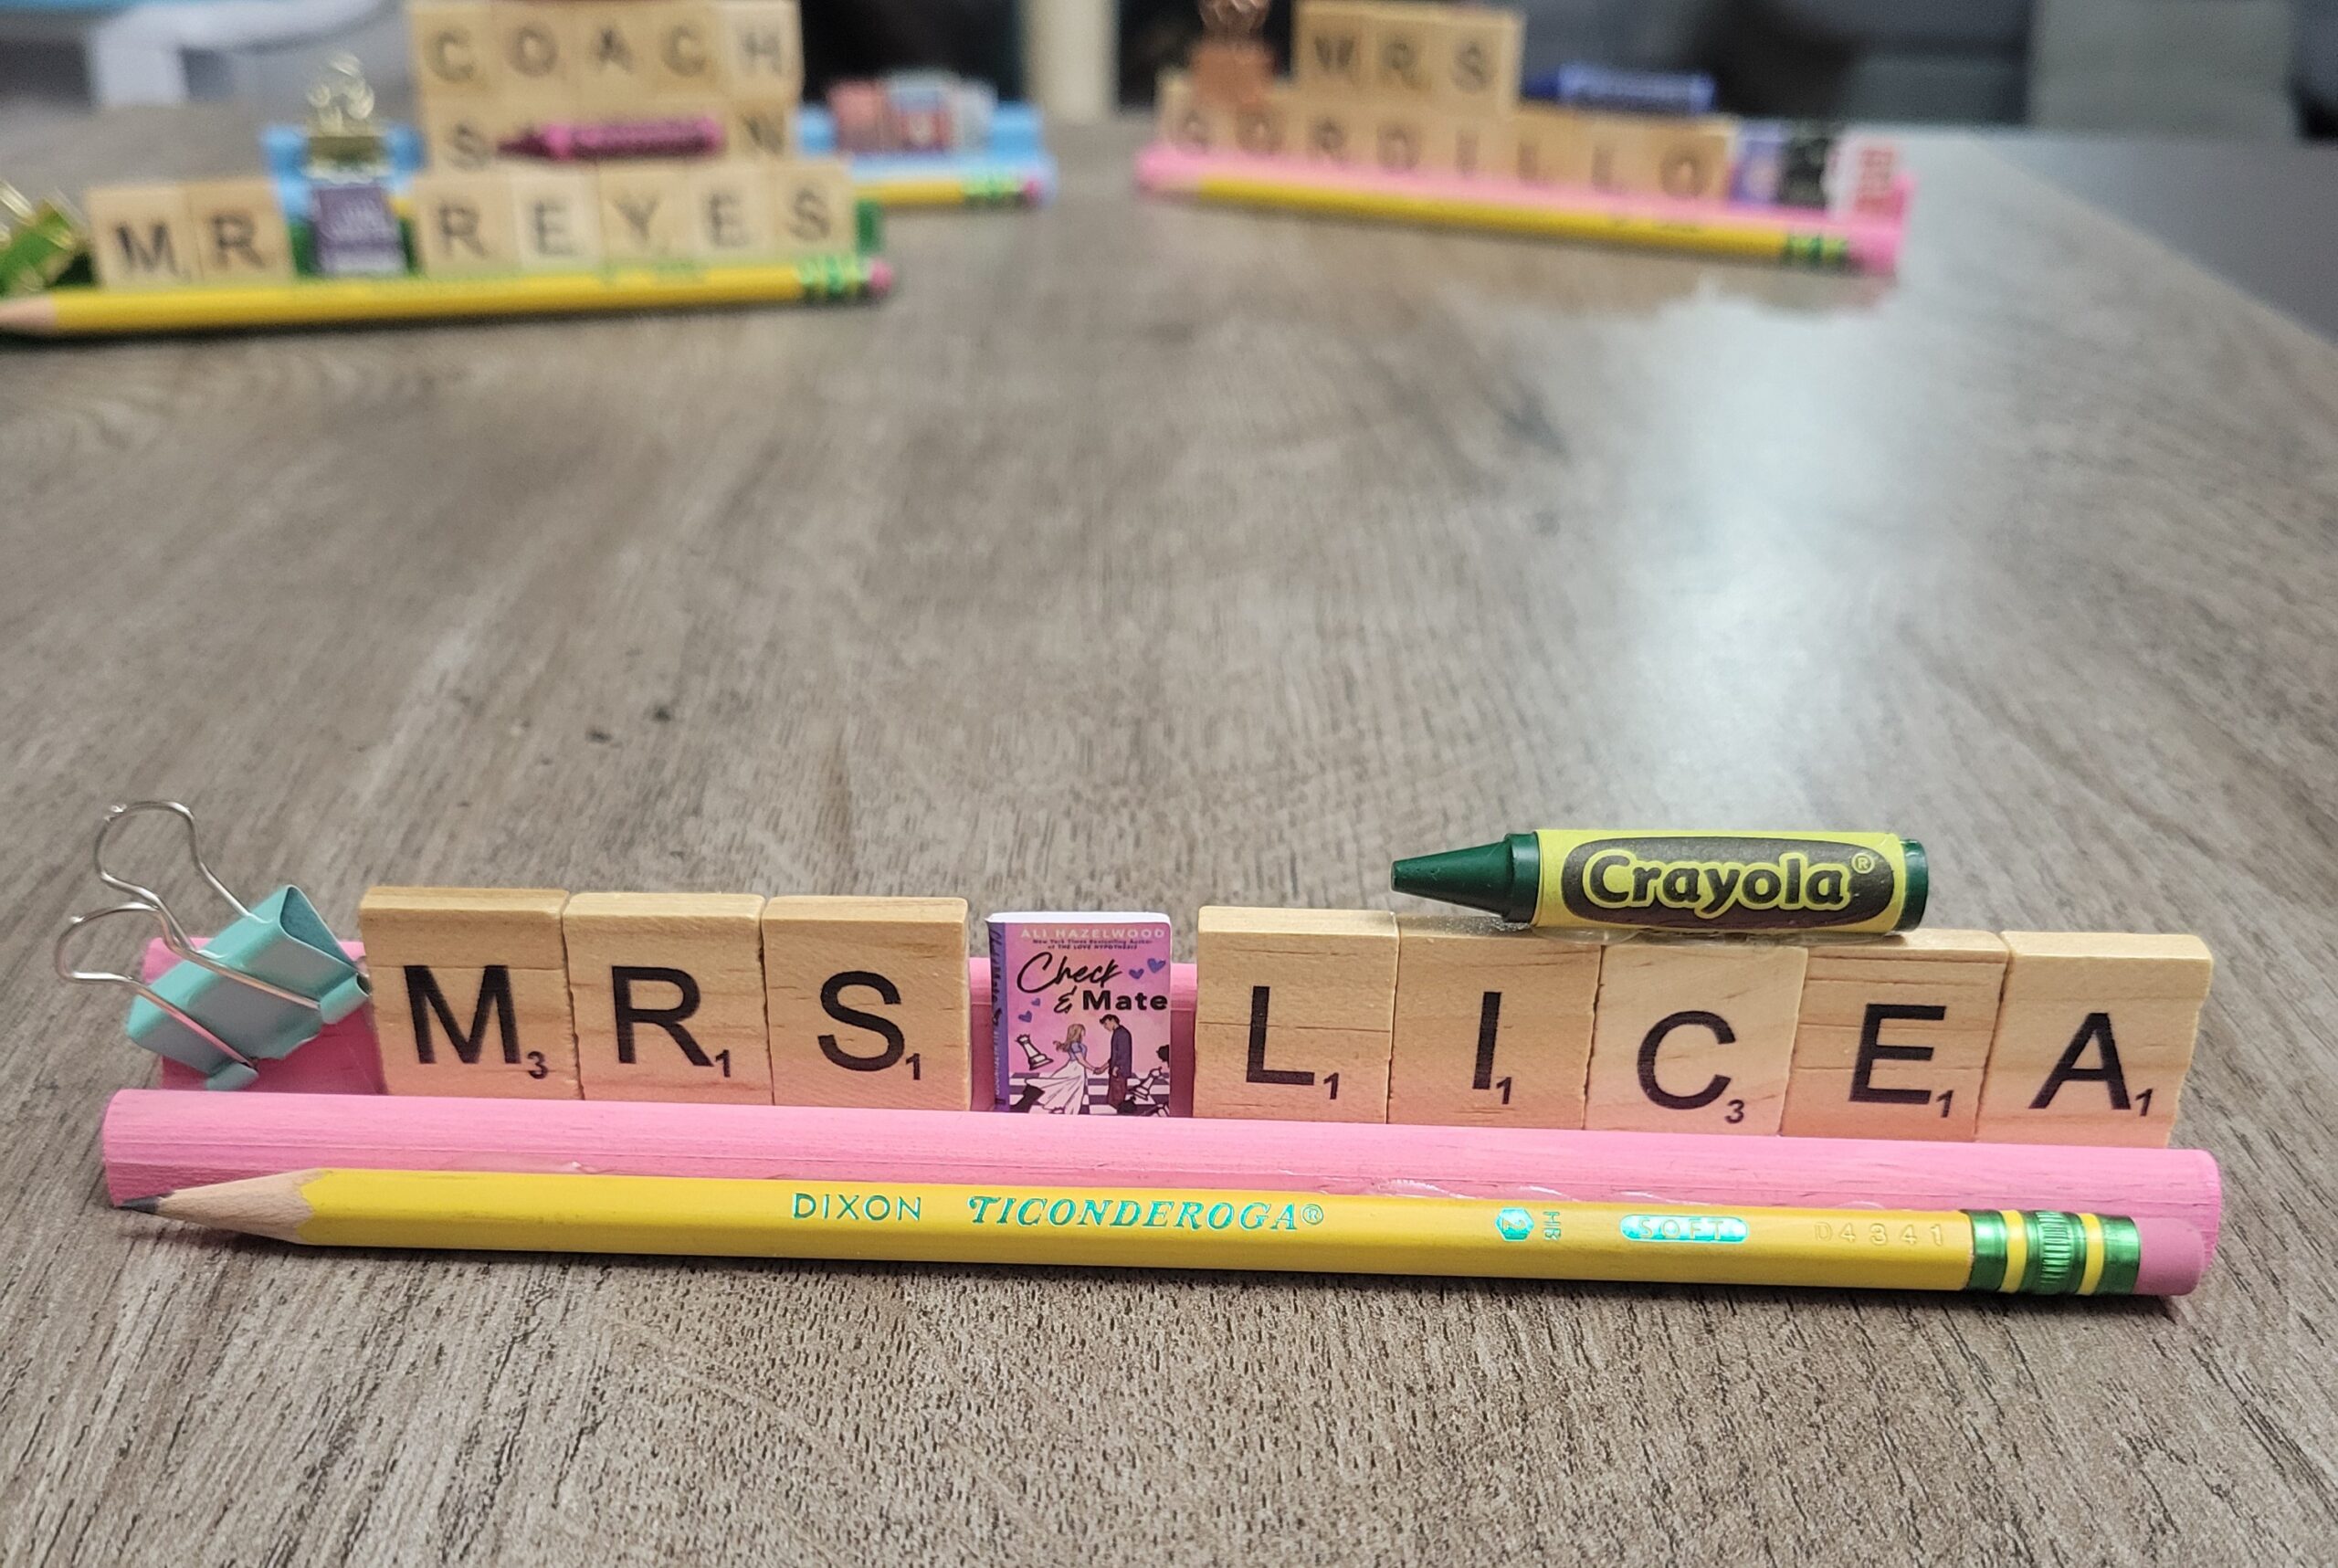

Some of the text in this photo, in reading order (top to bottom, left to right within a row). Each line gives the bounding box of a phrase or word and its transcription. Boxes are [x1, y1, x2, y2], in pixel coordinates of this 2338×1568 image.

[427, 23, 783, 83] COACH
[1313, 34, 1494, 87] MRS
[115, 188, 832, 276] MR REYES
[1021, 928, 1165, 939] ALI HAZELWOOD
[1016, 952, 1122, 994] Check
[1054, 985, 1168, 1014] & Mate
[404, 964, 2132, 1110] MRS LICEA
[791, 1193, 922, 1221] DIXON
[1543, 1211, 1561, 1241] HB
[1638, 1217, 1726, 1240] SOFT
